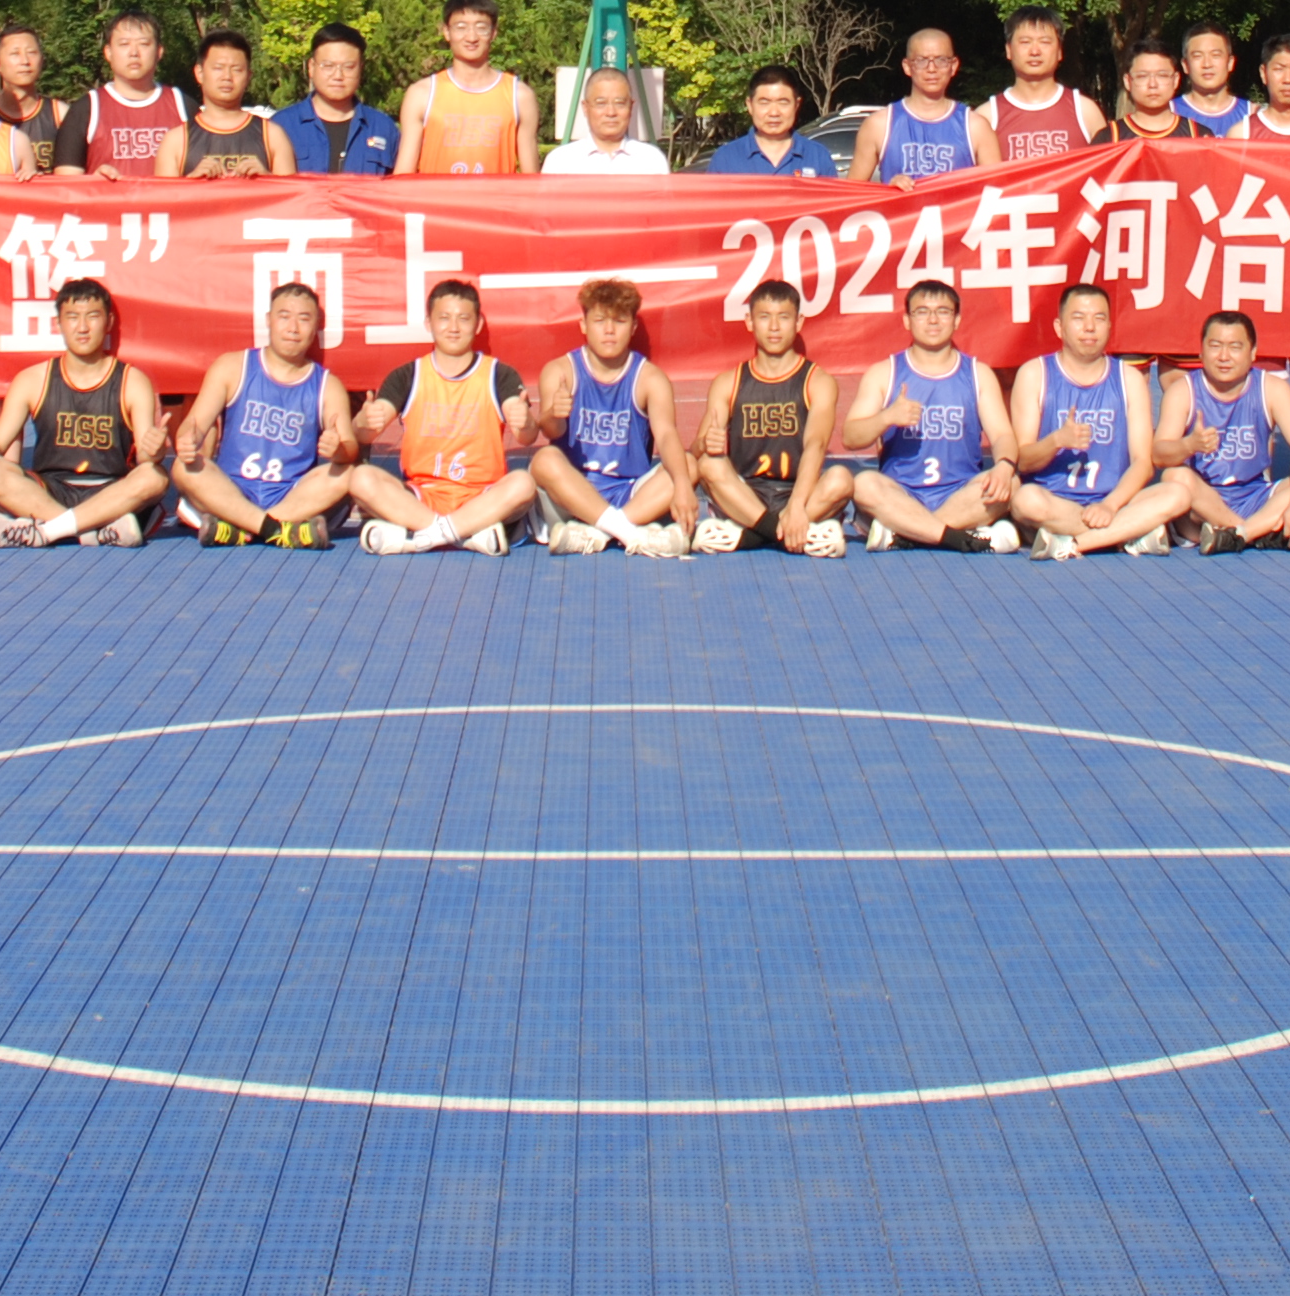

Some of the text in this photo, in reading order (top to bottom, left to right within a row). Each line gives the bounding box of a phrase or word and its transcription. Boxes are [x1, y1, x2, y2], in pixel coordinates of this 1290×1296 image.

[111, 127, 168, 159] HSS
[442, 114, 502, 147] HSS
[1008, 133, 1068, 161] HSS
[902, 143, 954, 175] HSS
[55, 412, 113, 450] HSS
[240, 400, 305, 445] HSS
[420, 402, 480, 439] HSS
[576, 407, 630, 445] HSS
[742, 401, 798, 437] HSS
[1202, 425, 1256, 461] SS
[241, 452, 283, 482] 68
[432, 451, 466, 481] 16
[923, 456, 941, 485] 3
